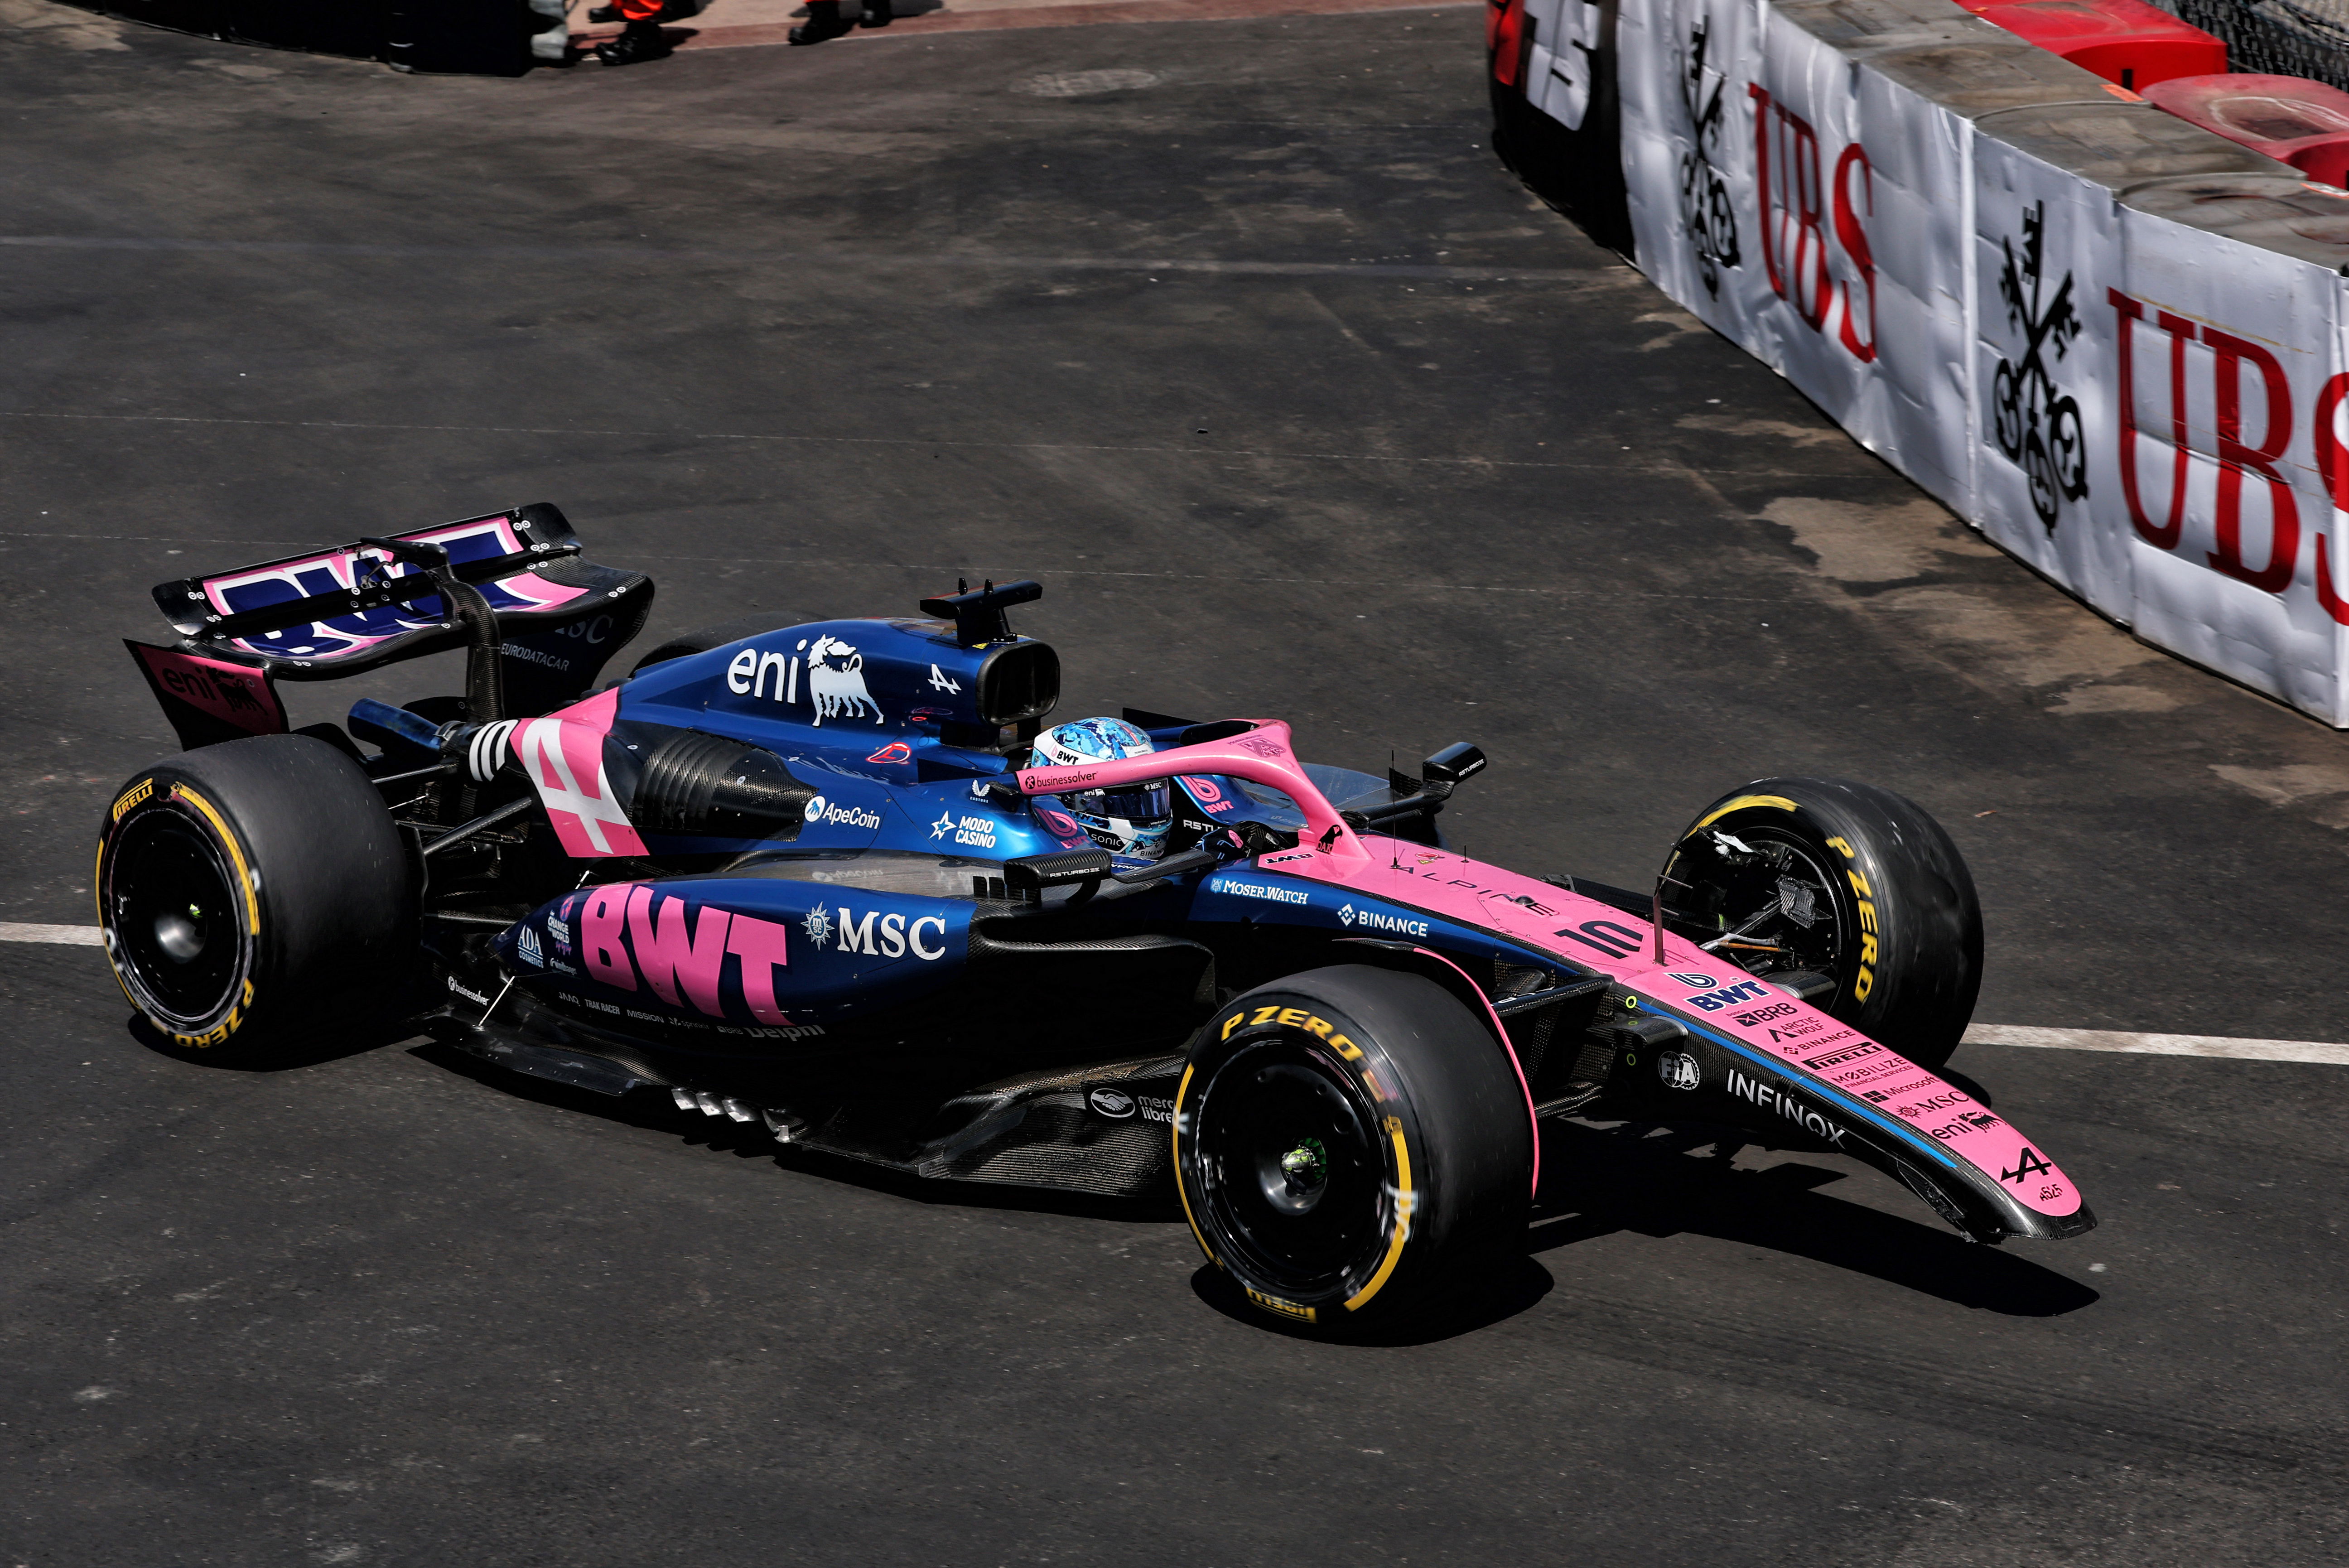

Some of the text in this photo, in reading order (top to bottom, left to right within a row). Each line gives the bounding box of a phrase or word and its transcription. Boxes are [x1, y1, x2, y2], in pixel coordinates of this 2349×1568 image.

[1748, 82, 1876, 363] UBS
[501, 643, 569, 671] EURODATACAR
[727, 639, 807, 704] eni
[162, 668, 216, 701] eni
[1056, 751, 1079, 765] BWT
[1037, 771, 1097, 787] businessolver
[113, 778, 153, 822] PIRELLI
[1204, 801, 1234, 814] BWT
[822, 802, 881, 829] ApeCoin
[958, 816, 994, 834] MODO
[955, 829, 996, 849] CASINO
[1060, 835, 1090, 849] BWT
[1223, 880, 1308, 904] MOSER.WATCH
[548, 916, 569, 935] CHANGE
[1359, 911, 1428, 937] BINANCE
[1826, 836, 1879, 1004] P ZERO
[518, 925, 543, 956] ADA
[551, 930, 569, 944] WORLD
[837, 907, 945, 960] MSC
[519, 950, 544, 969] COSMETICS
[581, 883, 796, 1026] BWT
[455, 980, 490, 1006] businessolver
[1683, 979, 1772, 1013] BWT
[584, 999, 600, 1011] TRAK
[601, 1003, 620, 1015] RACER
[627, 1009, 665, 1023] MISSION
[725, 1027, 743, 1035] BRB
[1752, 1003, 1798, 1023] BRB
[1780, 1017, 1819, 1031] ARCTIC
[1221, 1005, 1364, 1061] P ZERO
[1794, 1023, 1824, 1035] WOLF
[1798, 1030, 1856, 1050] BINANCE
[1801, 1042, 1882, 1070] PIRELLI
[1845, 1066, 1914, 1088] FINANCIAL SERVICES
[1883, 1076, 1940, 1096] Microsoft
[1138, 1095, 1174, 1109] merc
[1727, 1068, 1846, 1149] INFINOX
[1915, 1091, 1969, 1113] MSC
[1931, 1118, 1973, 1139] eni
